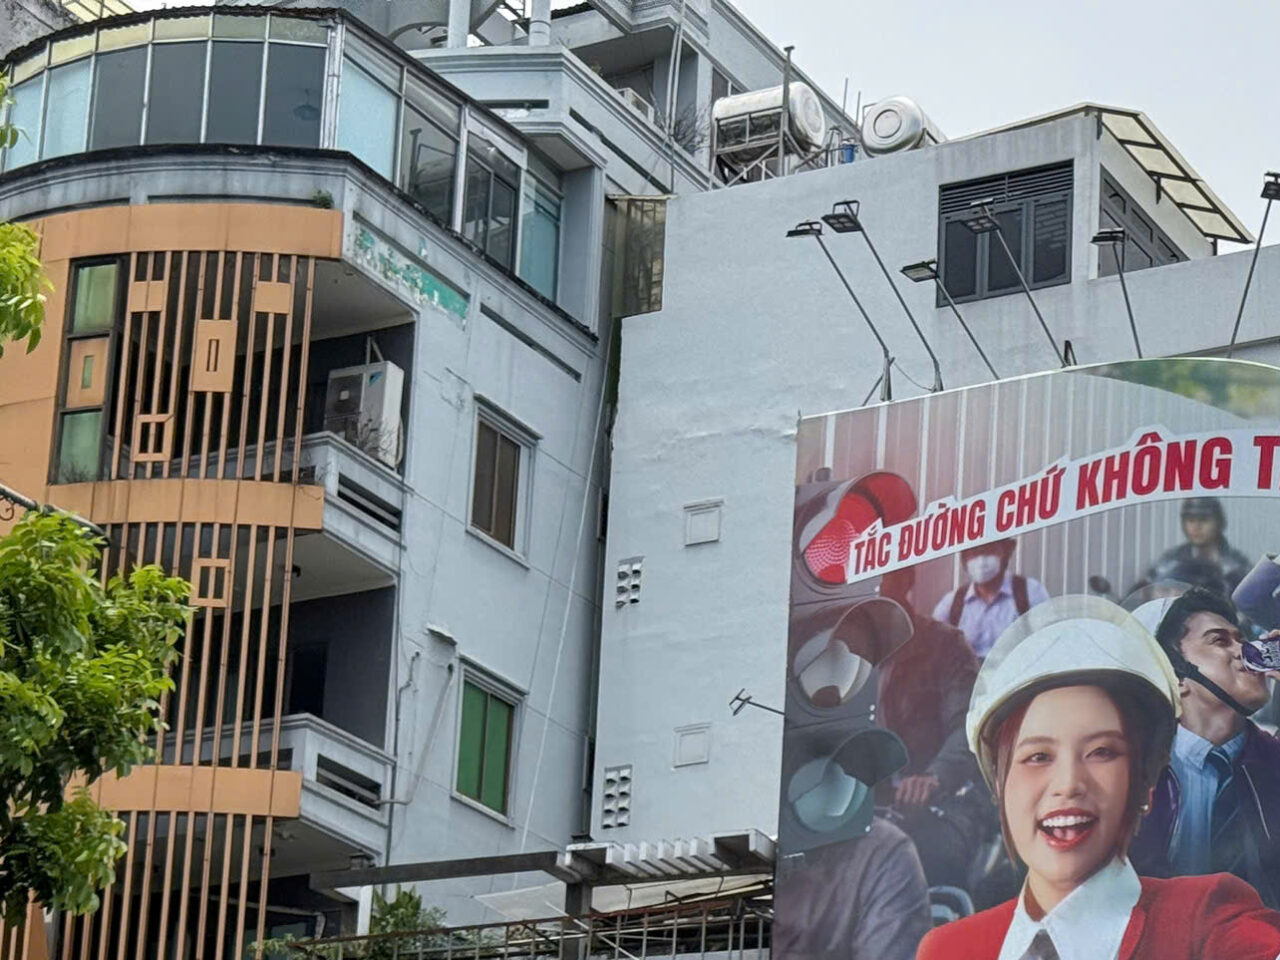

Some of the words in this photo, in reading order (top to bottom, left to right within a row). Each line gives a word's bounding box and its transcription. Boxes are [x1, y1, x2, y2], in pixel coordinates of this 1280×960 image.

[853, 523, 891, 575] TẮC
[898, 499, 986, 562] ĐƯỜNG
[996, 464, 1066, 533] CHỨ
[1076, 432, 1233, 510] KHÔNG
